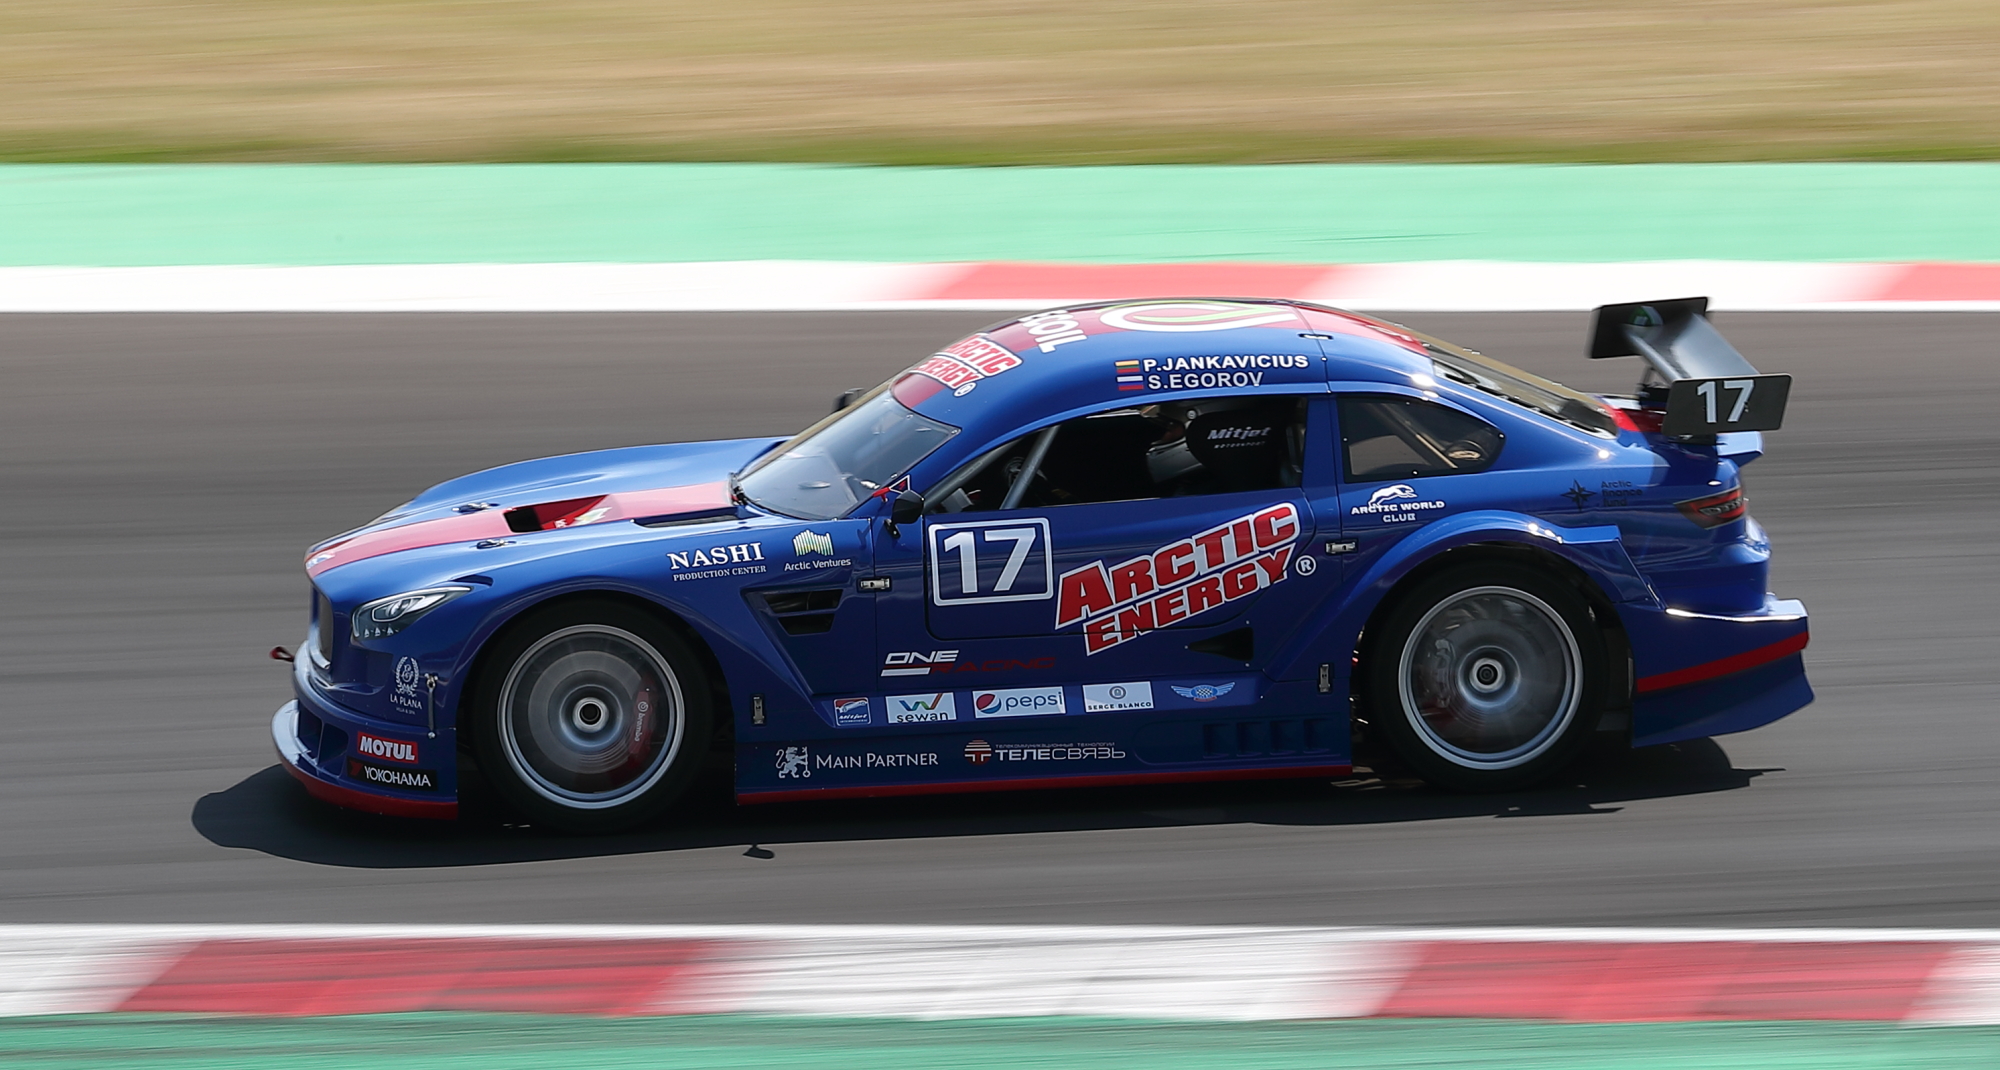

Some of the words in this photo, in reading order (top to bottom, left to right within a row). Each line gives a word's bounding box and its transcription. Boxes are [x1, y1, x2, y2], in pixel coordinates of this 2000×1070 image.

[1143, 355, 1309, 372] P.JANKAVICIUS
[1148, 372, 1263, 389] S.EGOROV
[1696, 379, 1755, 423] 17
[1207, 426, 1272, 440] Mitjet
[1351, 503, 1398, 515] ARCTIC
[1400, 501, 1445, 511] WORLD
[1382, 513, 1416, 523] CLUB
[667, 542, 765, 571] NASHI
[784, 560, 811, 572] Arctic
[812, 557, 852, 569] Ventures
[943, 527, 1037, 594] 17
[673, 568, 730, 582] PRODUCTION
[732, 564, 767, 577] CENTER
[1056, 504, 1299, 628] ARCTIC
[1085, 545, 1294, 655] ENERGY
[885, 650, 960, 665] ONE
[931, 657, 1056, 675] RACING
[390, 693, 399, 704] LA
[1005, 691, 1063, 711] pepsi
[1088, 703, 1115, 711] SERGE
[896, 711, 949, 723] sewan
[359, 736, 415, 761] MOTUL
[994, 747, 1126, 761] ТЕЛЕСВЯЗЬ
[364, 765, 432, 787] YOKOHAMA
